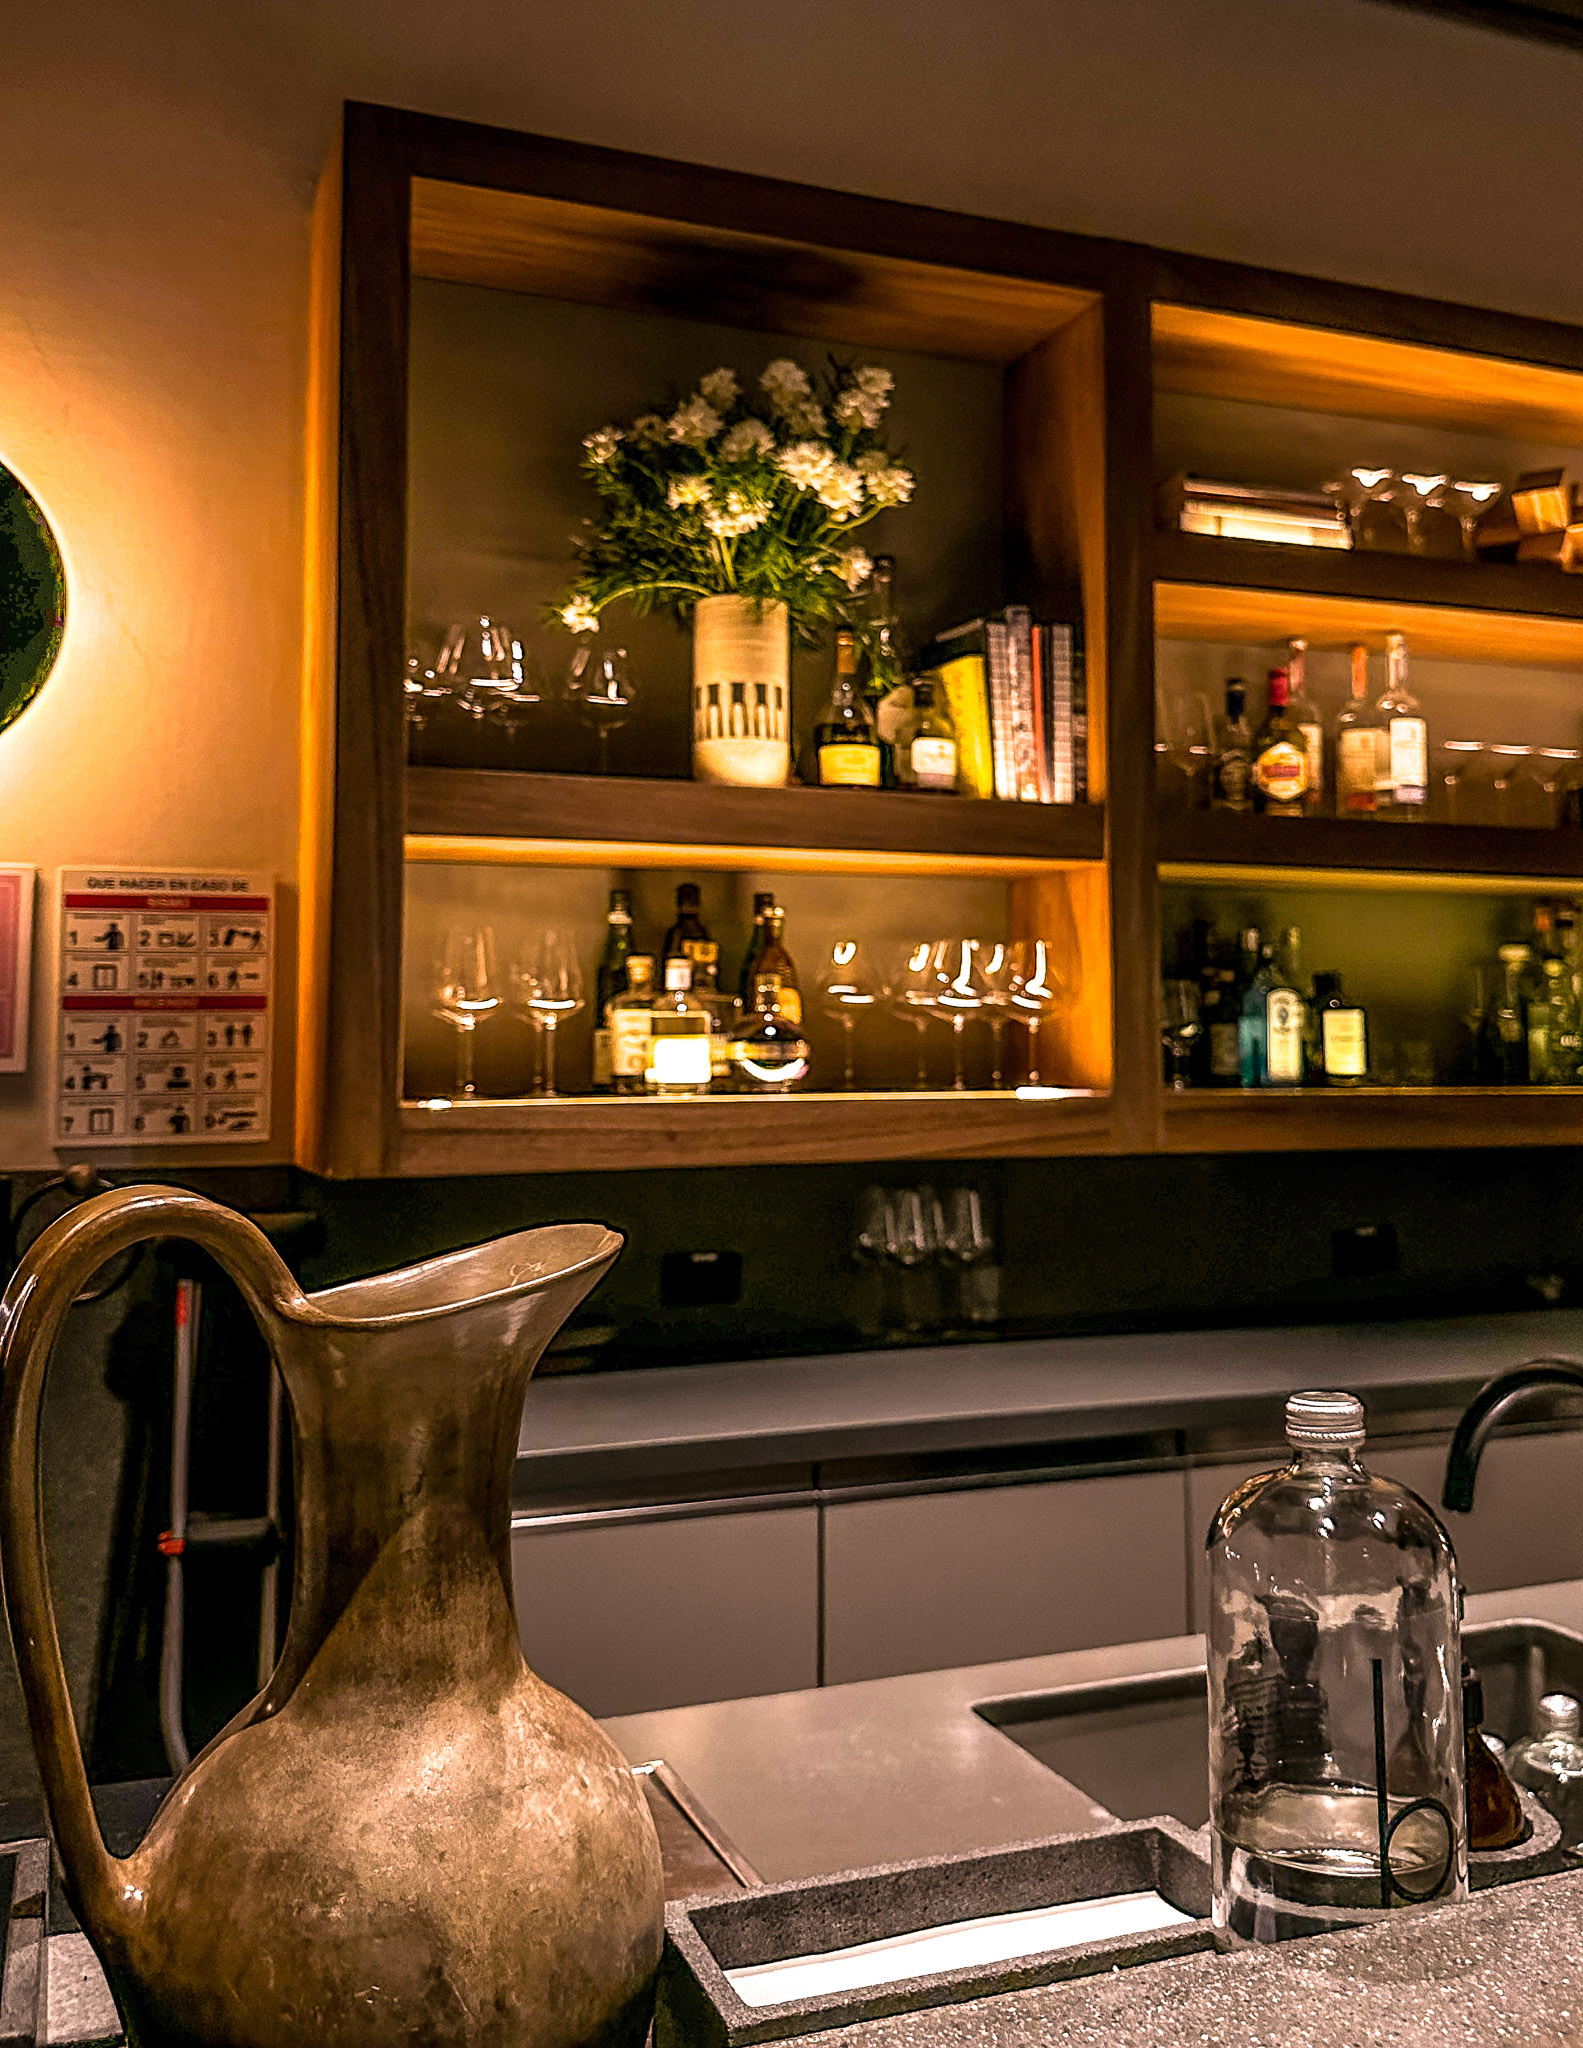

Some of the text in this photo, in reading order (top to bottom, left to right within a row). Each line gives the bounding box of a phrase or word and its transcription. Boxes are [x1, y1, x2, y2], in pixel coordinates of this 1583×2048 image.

[170, 879, 189, 890] EN
[232, 881, 249, 892] DE
[140, 931, 150, 947] 2
